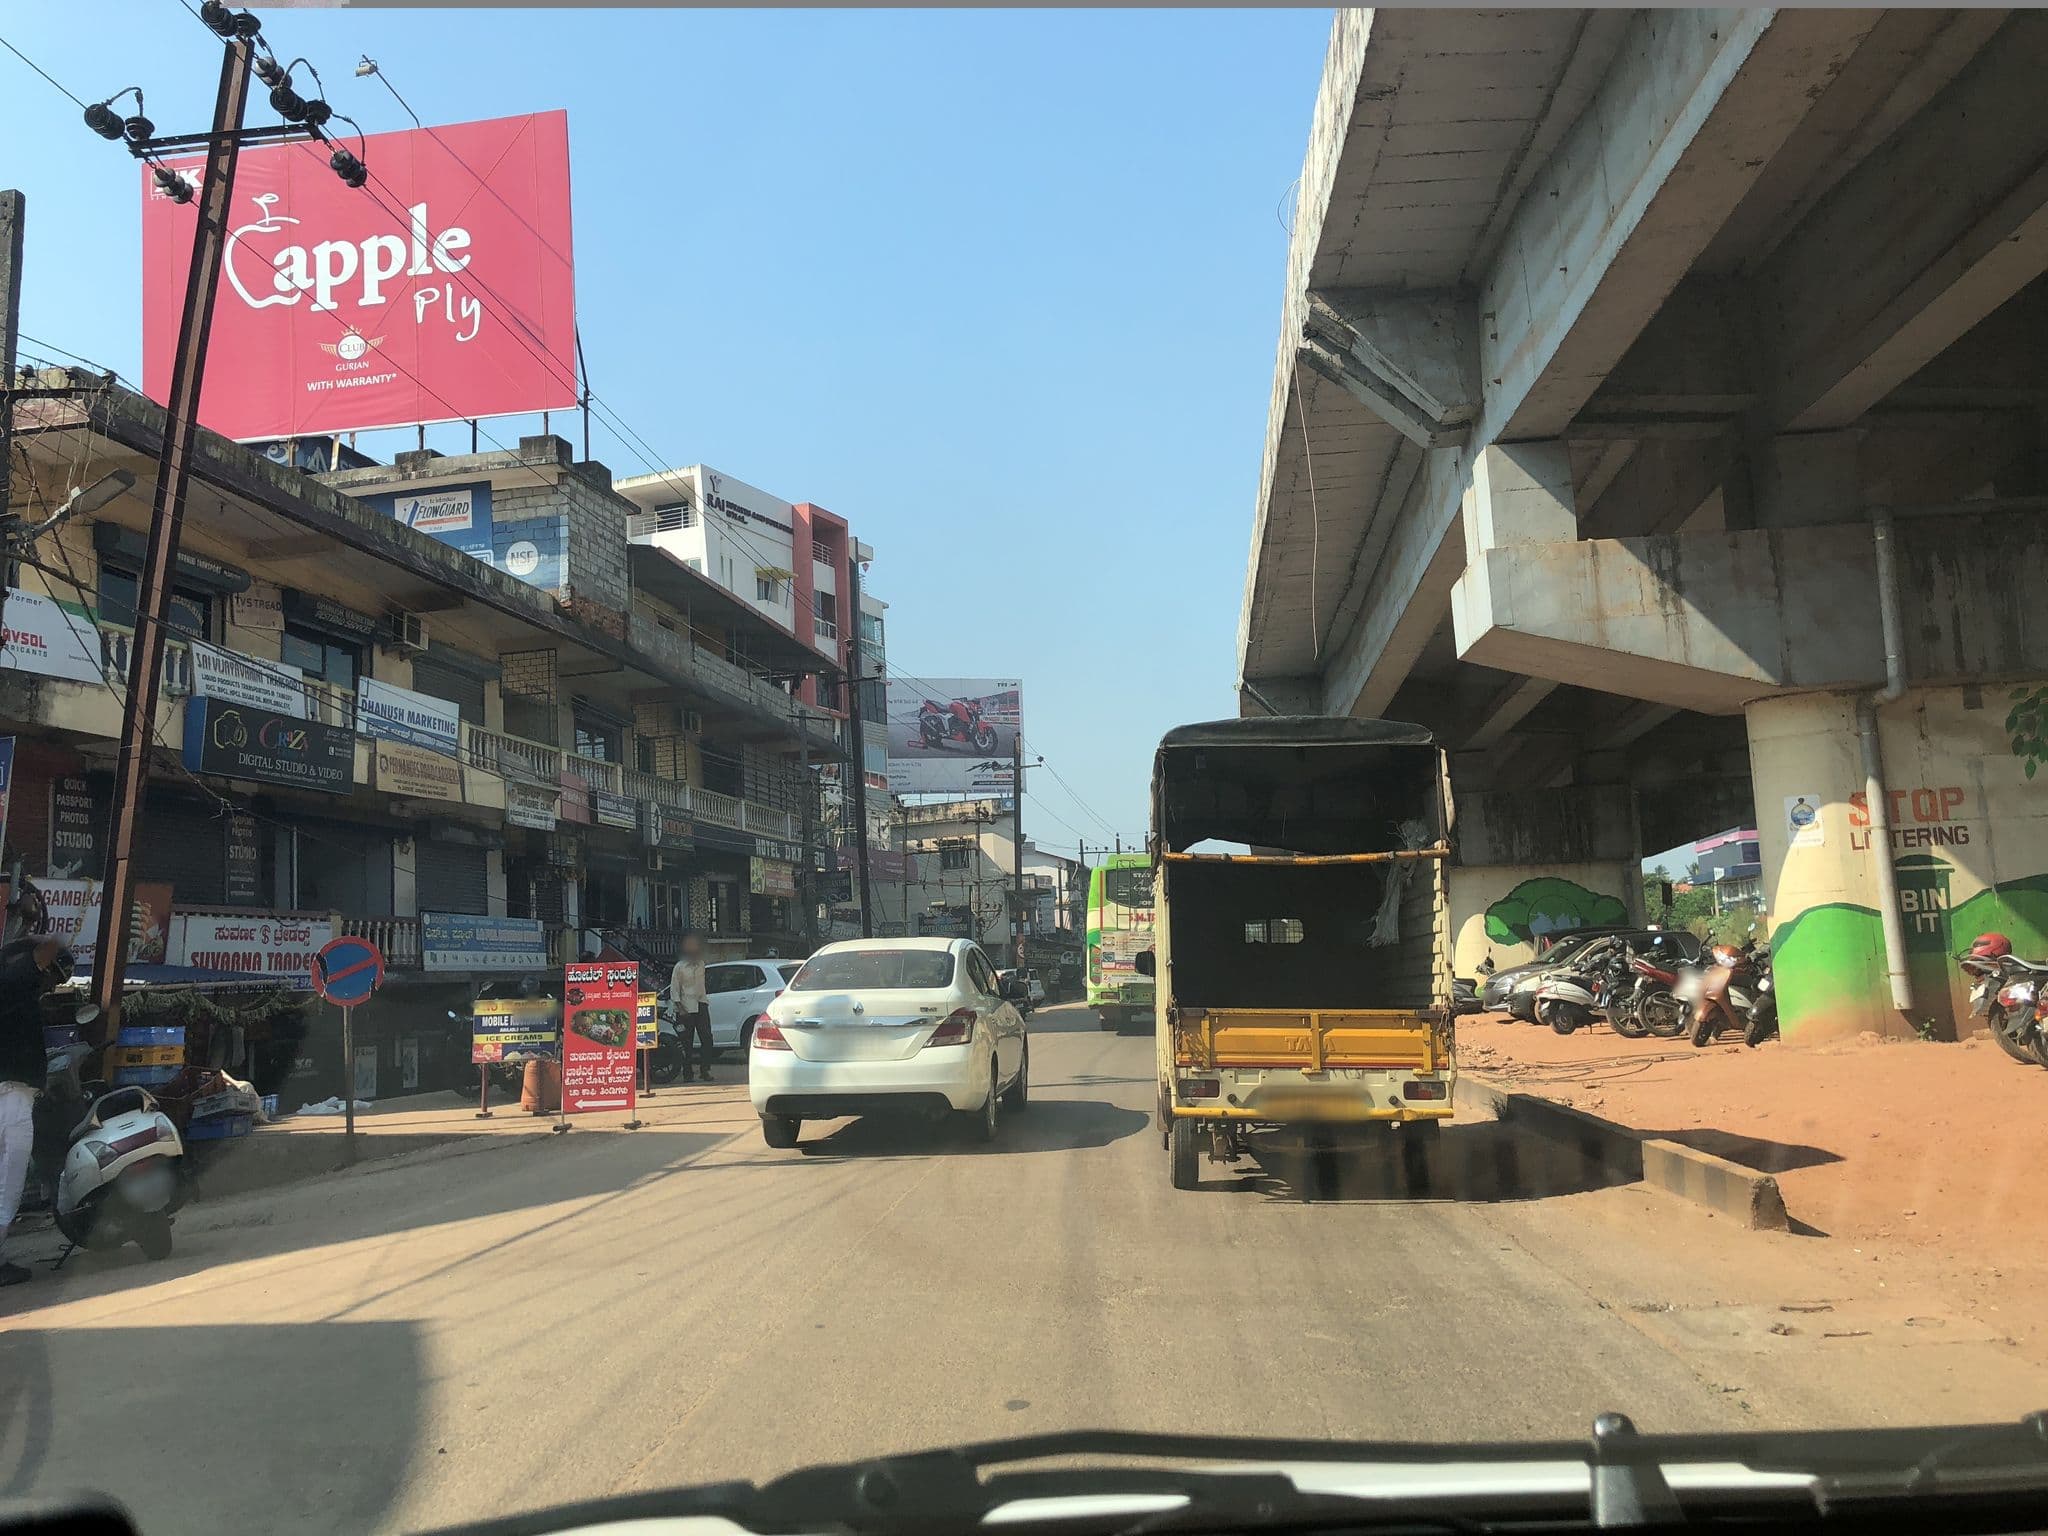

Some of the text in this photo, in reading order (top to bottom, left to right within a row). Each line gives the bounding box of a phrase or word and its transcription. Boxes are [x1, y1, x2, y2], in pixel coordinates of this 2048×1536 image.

[335, 360, 369, 372] GURJAN
[306, 381, 334, 391] WITH
[510, 550, 535, 566] NSF
[361, 698, 456, 735] DHANUSH MARKETING
[239, 752, 274, 769] DIGITAL
[275, 759, 308, 775] STUDIO
[318, 766, 344, 781] VIDEO
[64, 778, 87, 791] QUICK
[56, 793, 93, 809] PASSPORT
[60, 811, 89, 825] PHOTOS
[55, 830, 93, 850] STUDIO
[1850, 825, 1970, 851] LITERING
[755, 837, 781, 858] HOTEL
[1901, 887, 1948, 913] BIN
[1915, 912, 1939, 933] IT
[191, 951, 262, 971] SUVARNA
[568, 966, 603, 982] ಹೋಟೆಲ್
[481, 1015, 509, 1027] MOBILE
[503, 1033, 544, 1041] CREAMS
[1284, 1035, 1336, 1053] TAA
